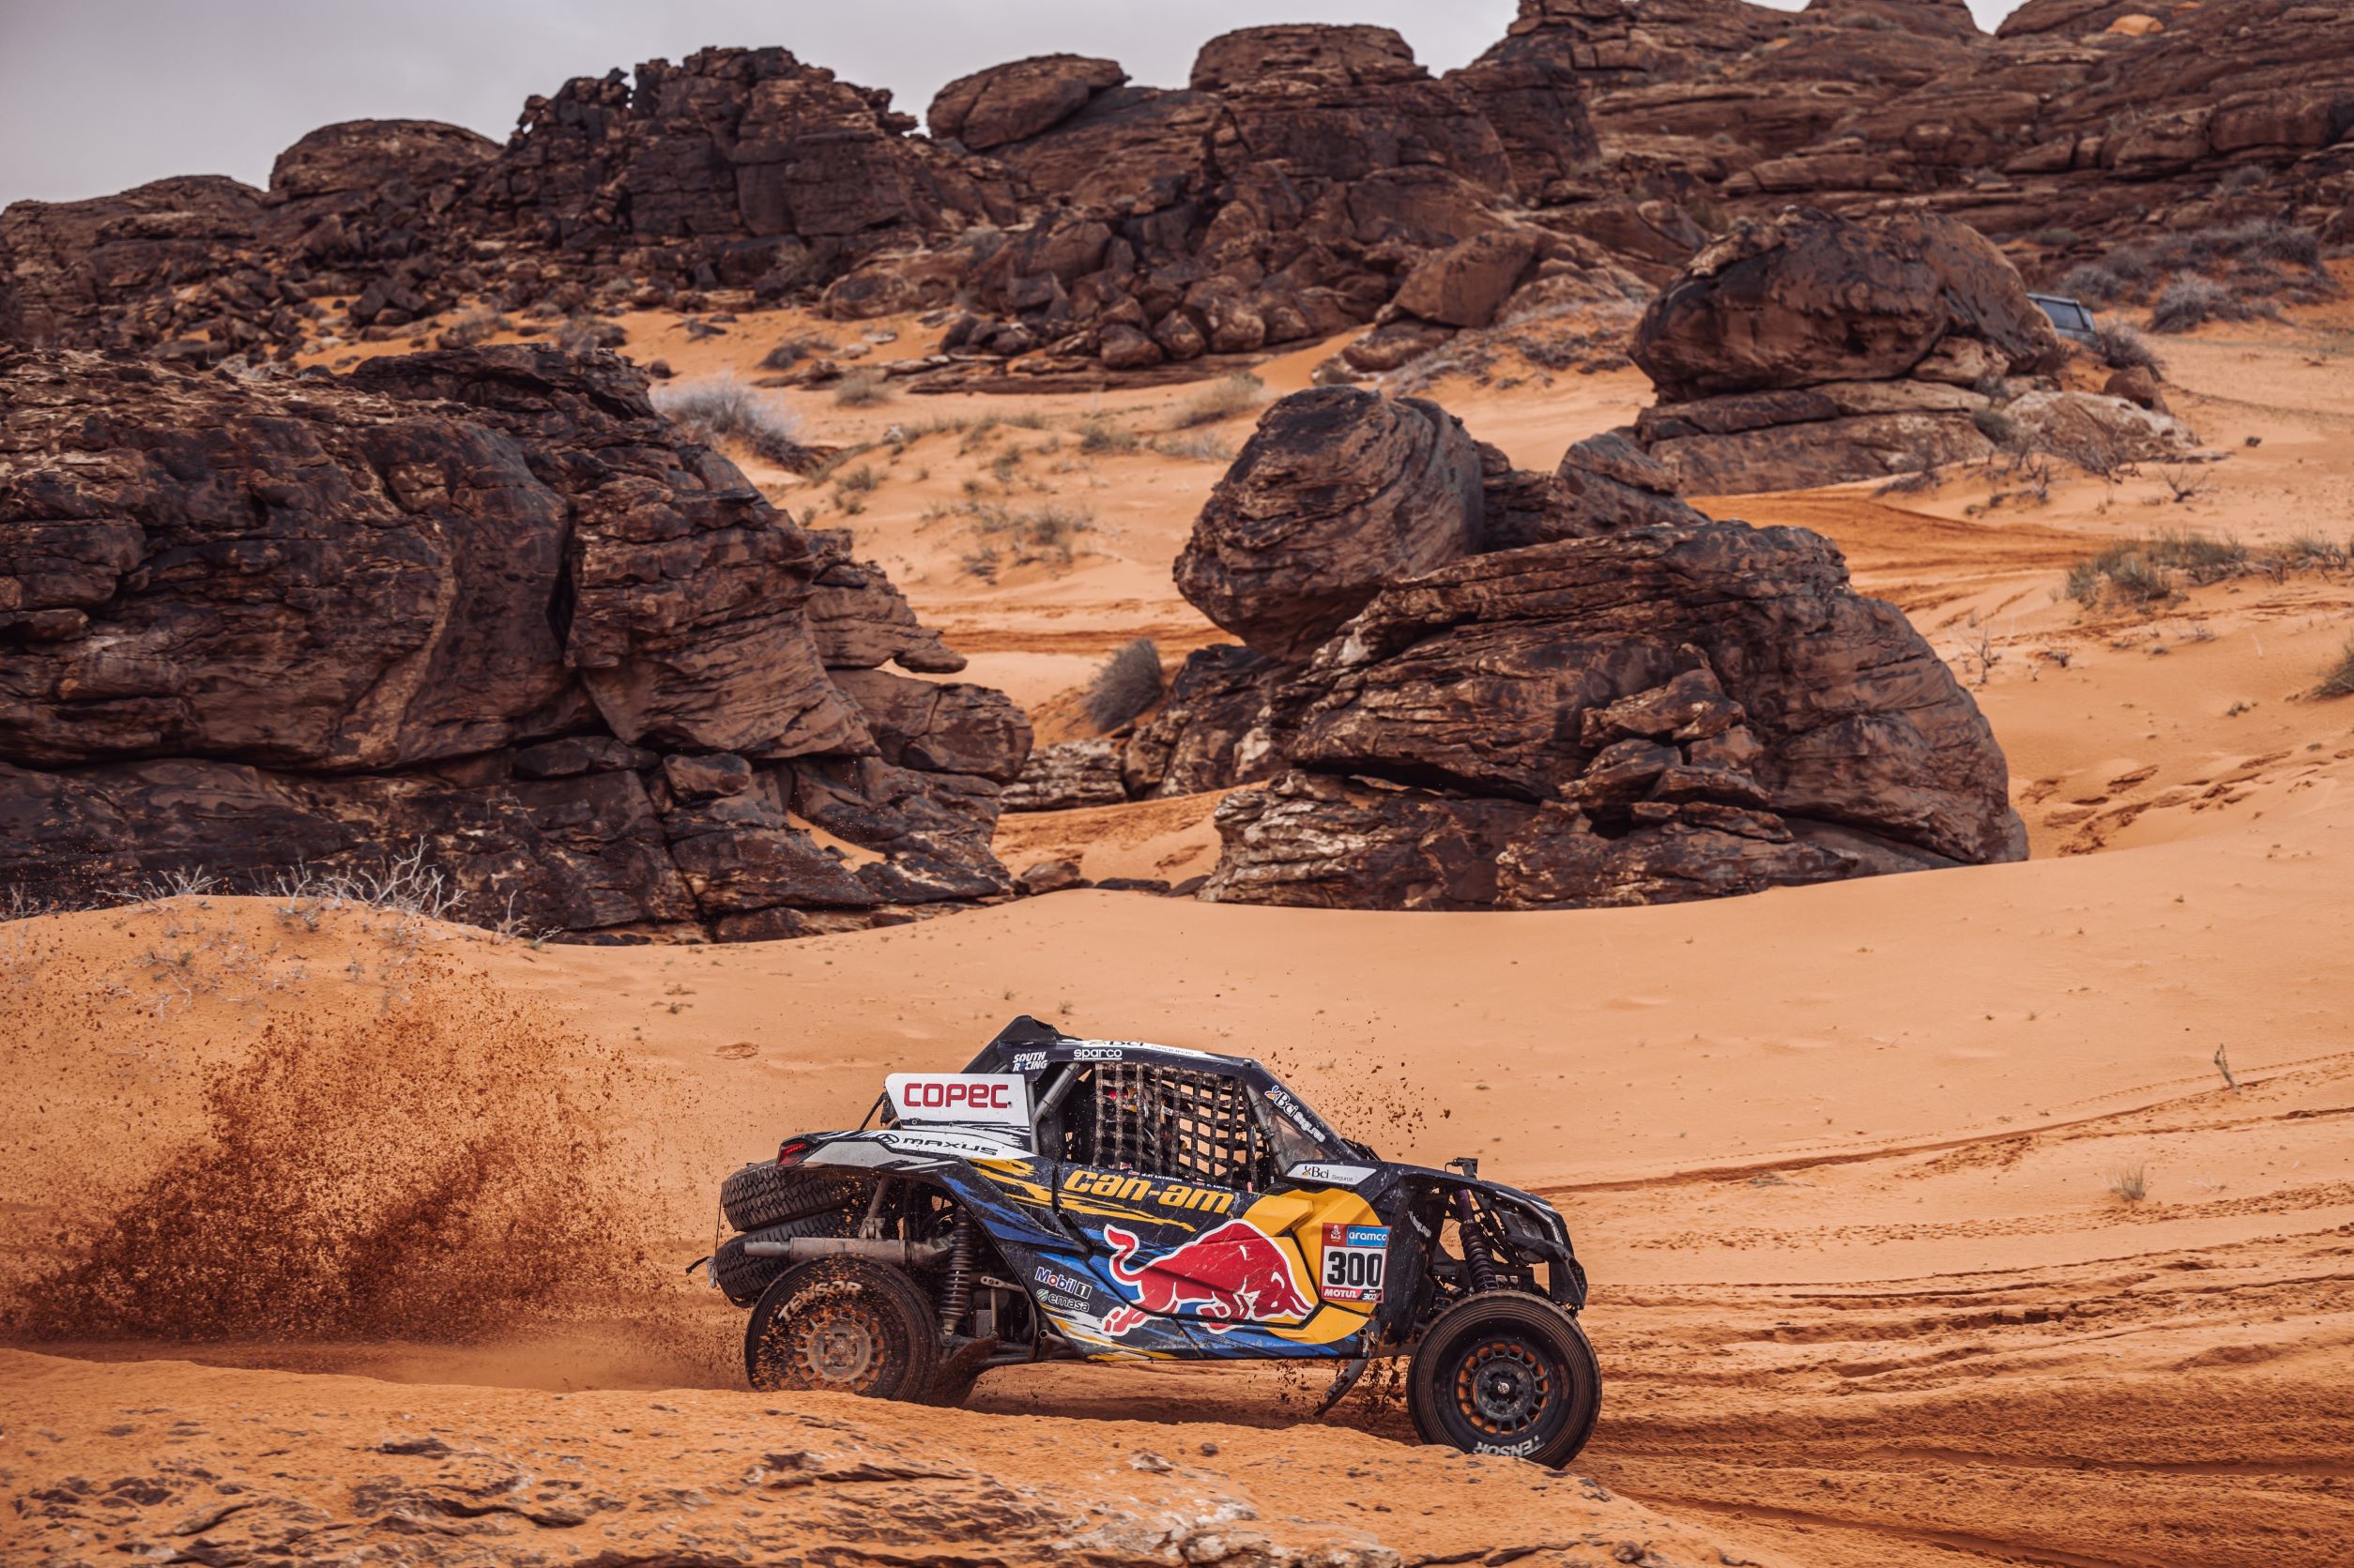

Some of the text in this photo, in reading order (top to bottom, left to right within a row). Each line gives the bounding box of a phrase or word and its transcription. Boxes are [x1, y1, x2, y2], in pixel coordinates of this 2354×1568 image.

[1013, 1051, 1047, 1063] SOUTH
[1073, 1048, 1123, 1060] sparco
[1274, 1091, 1299, 1118] Bci
[903, 1137, 999, 1156] MAXUS
[1311, 1166, 1330, 1180] Bci
[1063, 1169, 1234, 1214] can-am
[1348, 1231, 1388, 1241] aramco
[1326, 1251, 1383, 1287] 300
[1034, 1266, 1078, 1294] Mobil
[1047, 1293, 1089, 1313] emasa
[1323, 1288, 1358, 1299] MOTUL
